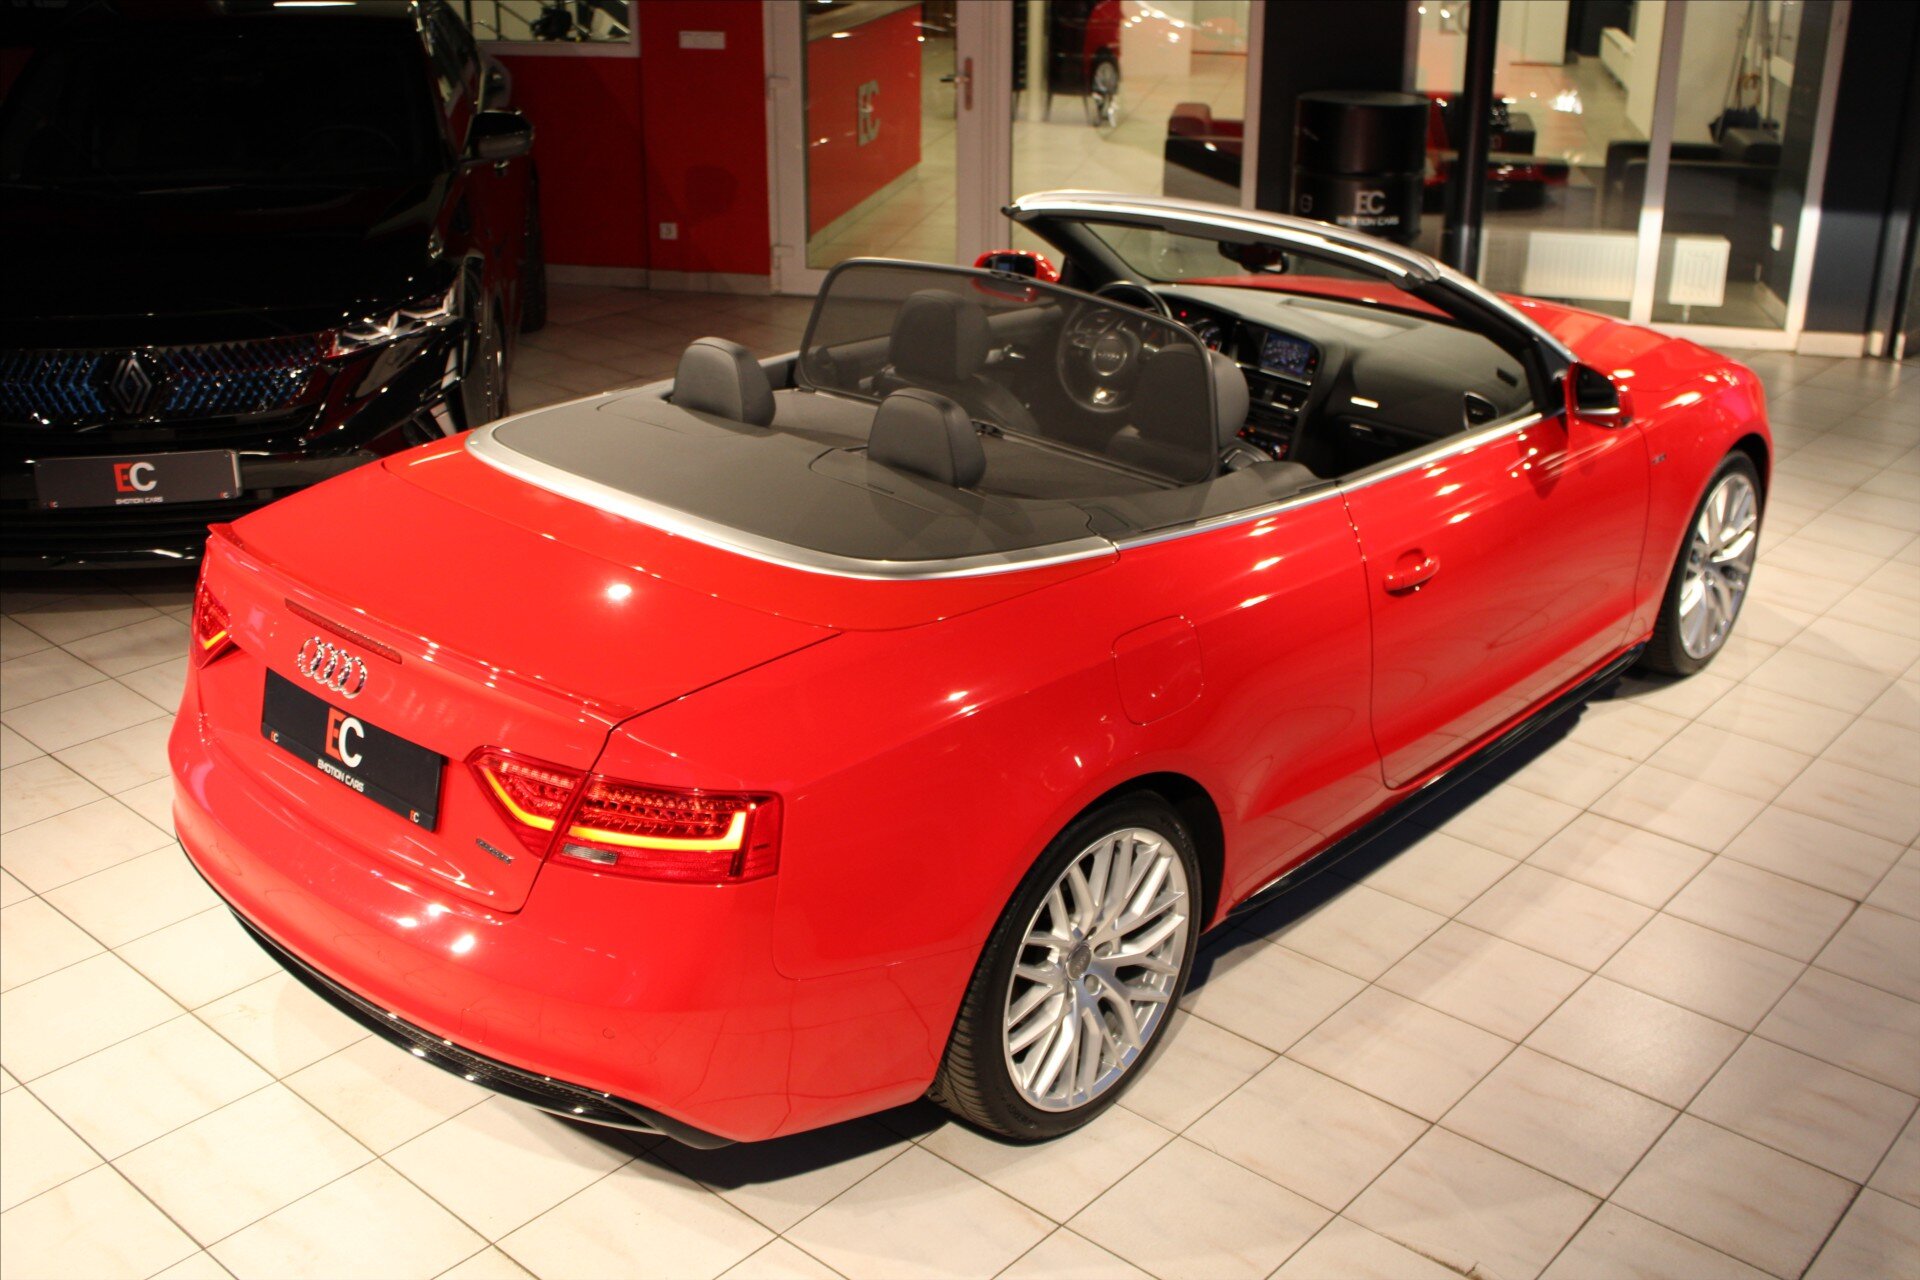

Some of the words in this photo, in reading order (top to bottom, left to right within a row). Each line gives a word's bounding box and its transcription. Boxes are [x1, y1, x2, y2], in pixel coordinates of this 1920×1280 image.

[1355, 190, 1386, 215] EC
[113, 462, 157, 492] EC
[325, 706, 365, 768] EC
[317, 758, 345, 782] EMOTION
[345, 774, 365, 793] CARS
